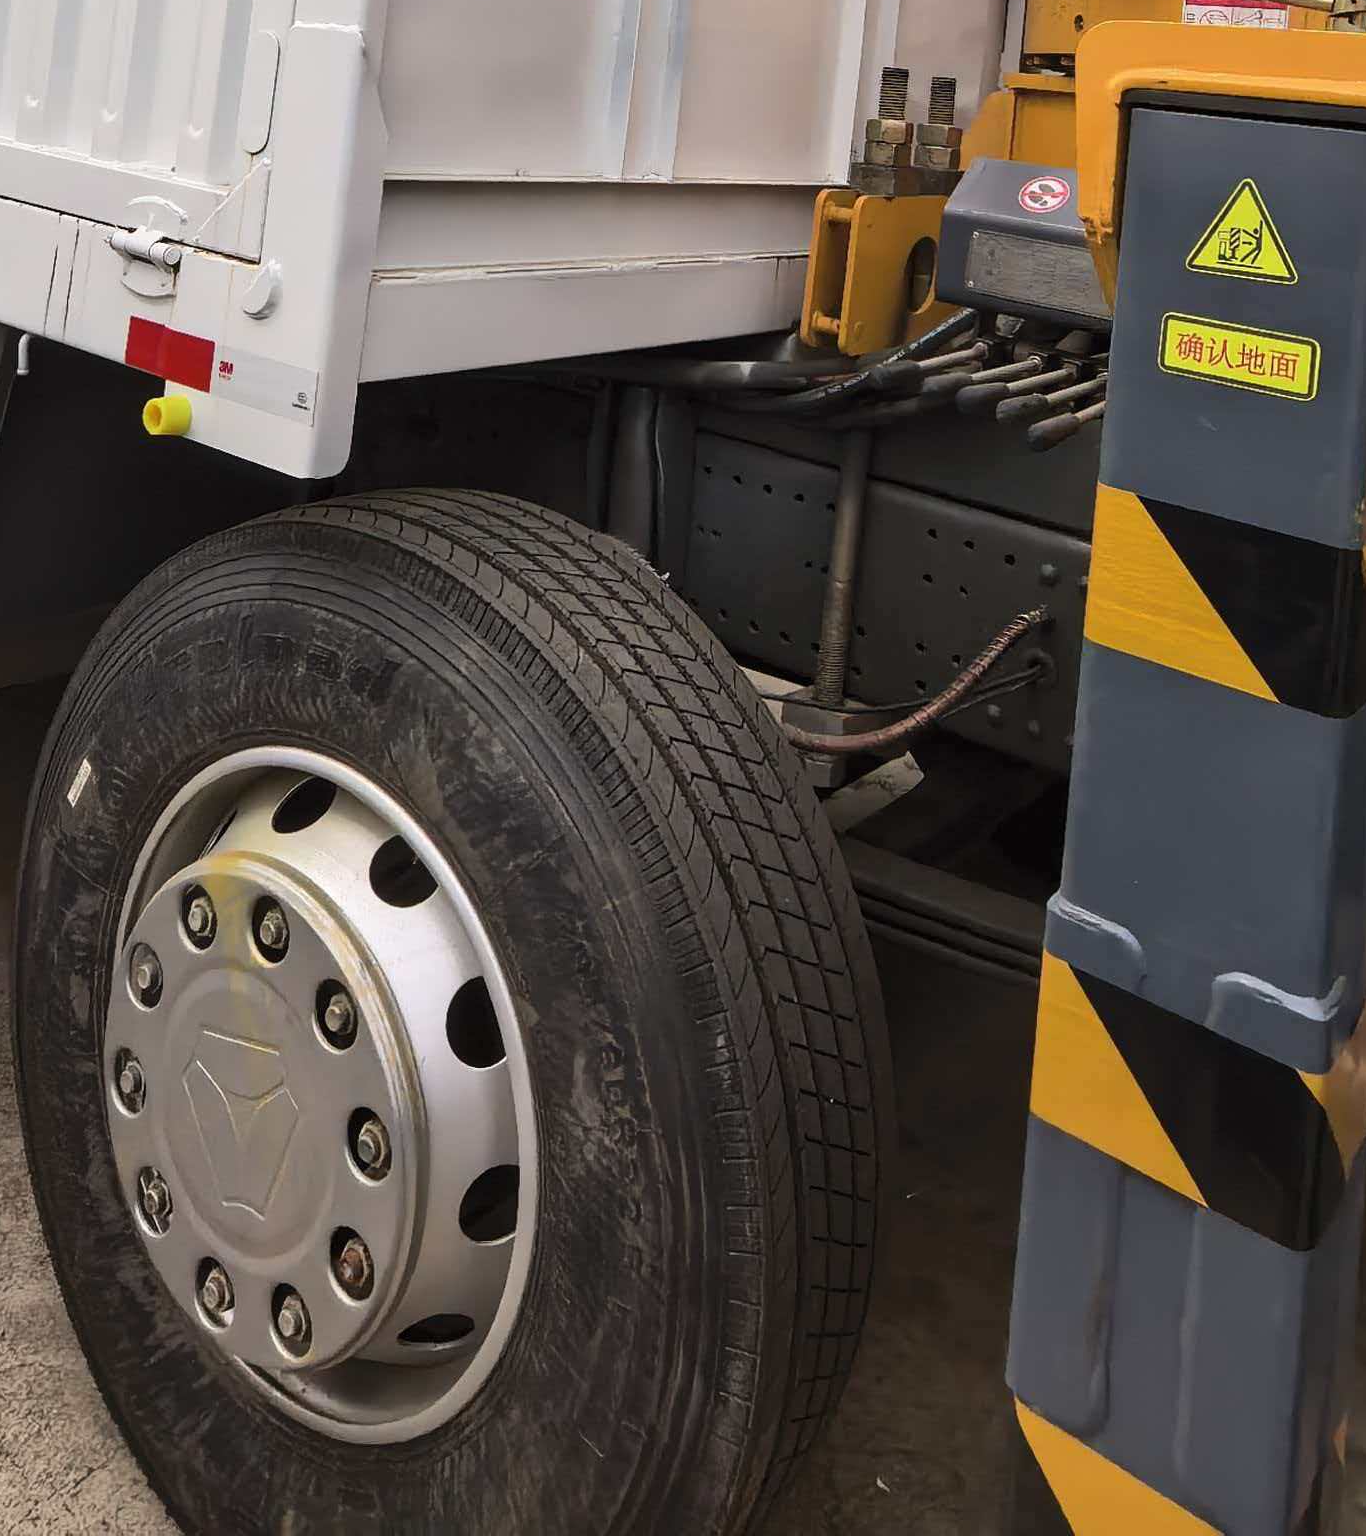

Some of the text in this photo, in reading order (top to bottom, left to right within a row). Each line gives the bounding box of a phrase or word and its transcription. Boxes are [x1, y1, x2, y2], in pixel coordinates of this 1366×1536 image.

[218, 360, 234, 375] 3M
[1175, 331, 1301, 383] 确认地面
